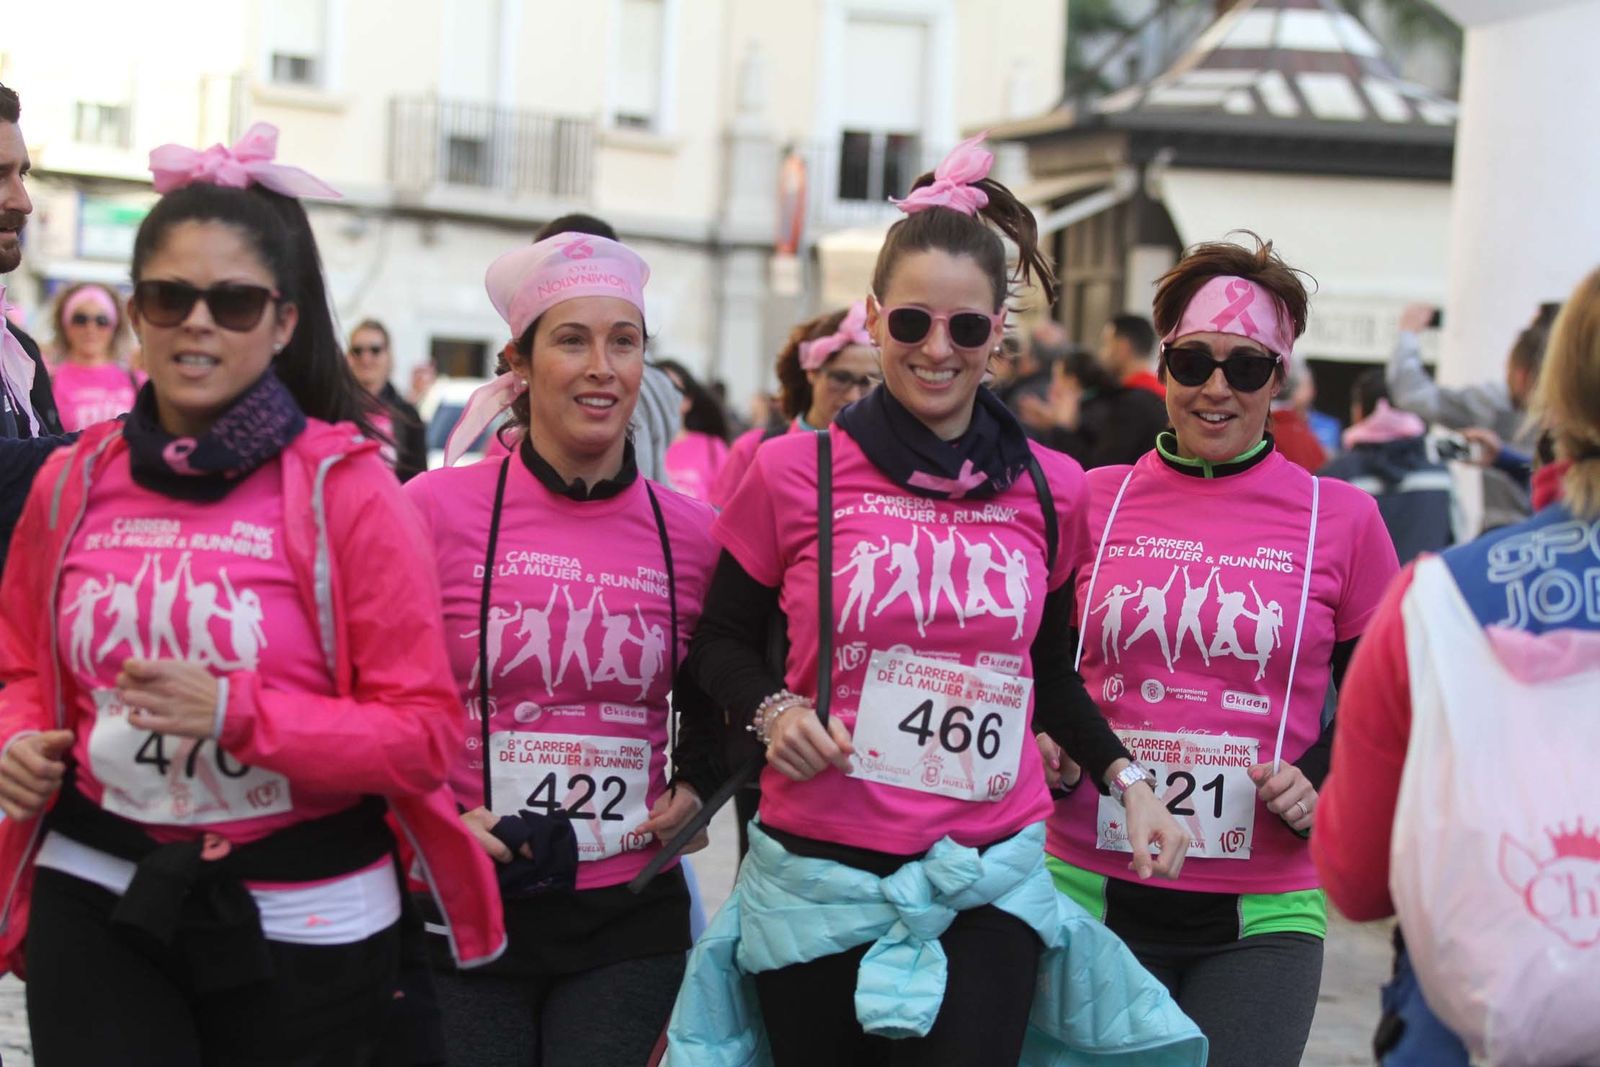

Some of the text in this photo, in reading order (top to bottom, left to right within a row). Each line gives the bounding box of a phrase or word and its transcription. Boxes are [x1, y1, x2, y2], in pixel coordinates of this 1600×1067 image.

[537, 272, 633, 297] NOMINATION
[864, 492, 935, 510] CARRERA
[833, 505, 854, 519] DE
[859, 504, 879, 514] LA
[883, 505, 936, 523] MUJER
[939, 513, 949, 524] &
[1109, 545, 1294, 573] DE LA MUJER & RUNNING
[1136, 535, 1293, 563] CARRERA PINK
[1487, 520, 1600, 584] SP
[506, 550, 582, 569] CARRERA
[499, 564, 519, 577] LA
[523, 563, 581, 582] MUJER
[586, 573, 595, 584] &
[601, 572, 669, 598] RUNNING
[905, 662, 964, 684] CARRERA
[877, 669, 894, 684] DE
[897, 673, 914, 688] LA
[917, 676, 962, 698] MUJER
[966, 689, 973, 700] &
[976, 689, 1022, 709] RUNNING
[1166, 686, 1208, 696] Ayuntamiento
[1175, 692, 1207, 703] de Huelva
[1225, 693, 1268, 709] ekiden
[898, 699, 1003, 760] 466
[524, 739, 582, 754] CARRERA
[619, 745, 645, 758] PINK
[1131, 738, 1181, 752] CARRERA
[1223, 743, 1250, 756] PINK
[500, 751, 644, 770] DE LA MUJER & RUNNING
[1141, 750, 1181, 764] MUJER
[1183, 755, 1191, 765] &
[1195, 754, 1251, 768] RUNNING
[526, 772, 627, 821] 422
